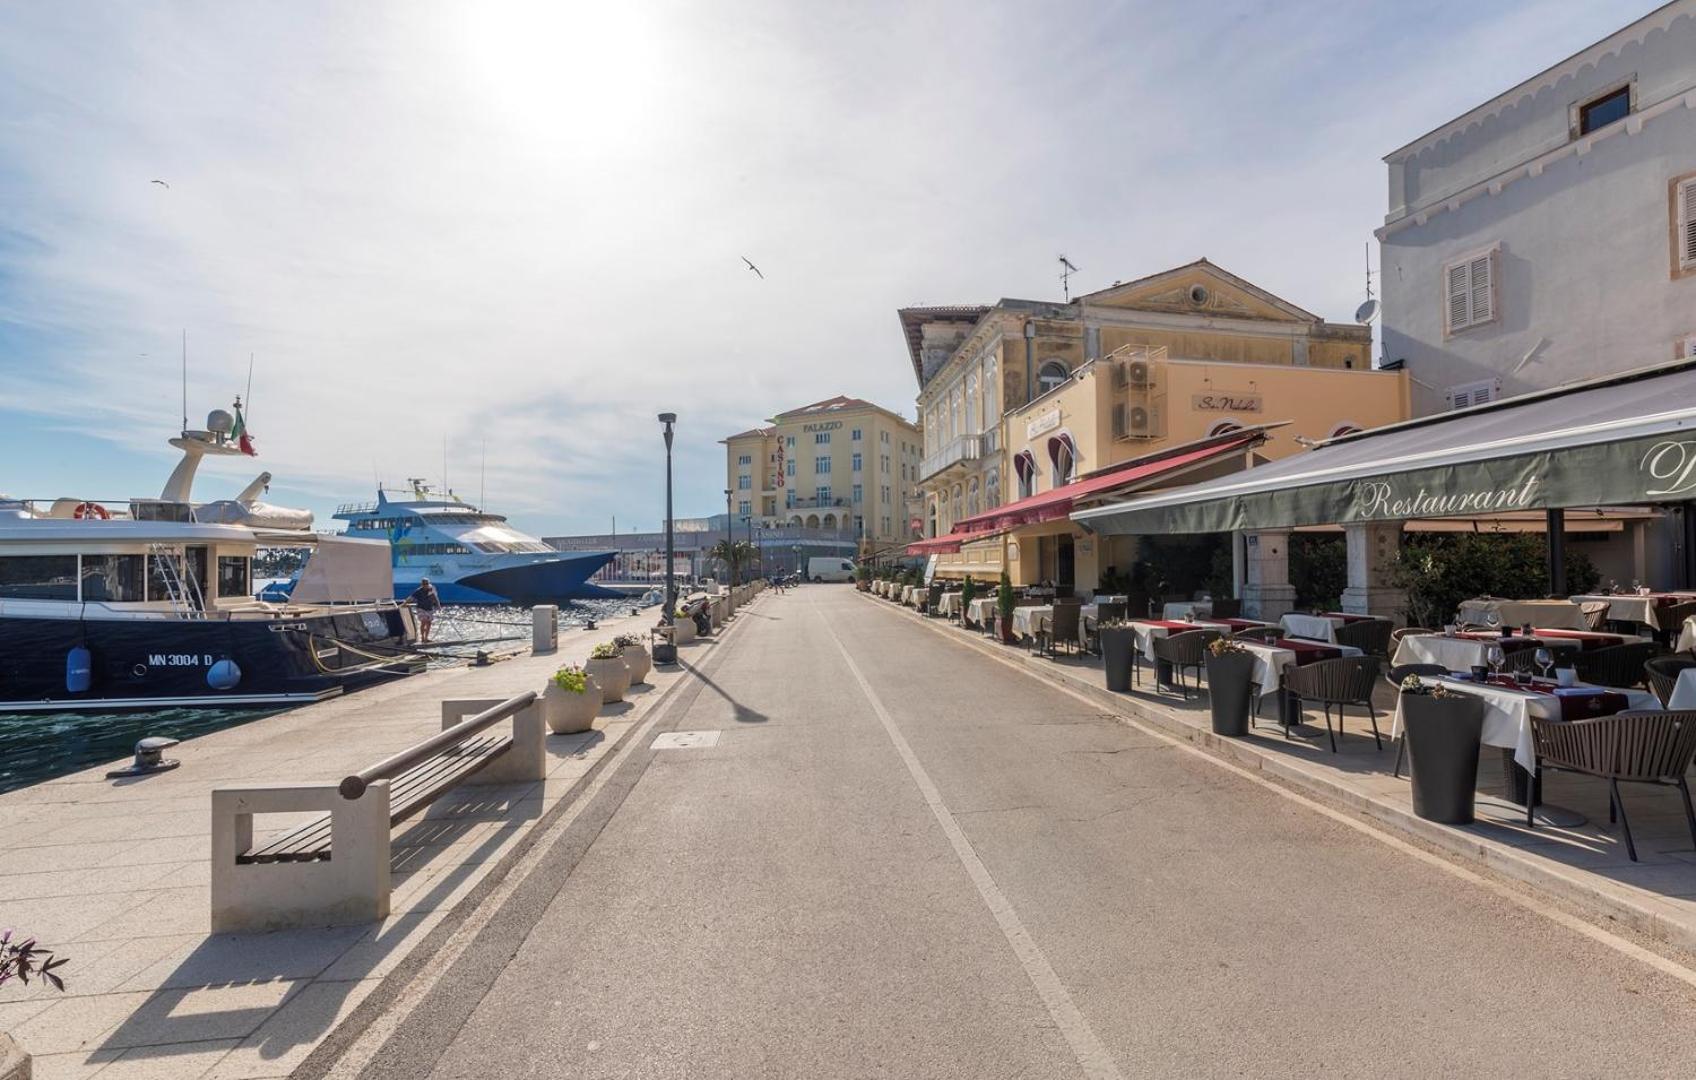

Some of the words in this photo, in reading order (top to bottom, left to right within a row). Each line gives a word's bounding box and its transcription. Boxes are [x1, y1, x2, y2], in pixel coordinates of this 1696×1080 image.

[803, 421, 843, 433] PALAZZO
[777, 435, 785, 487] CASINO
[1360, 475, 1540, 518] Restaurant
[148, 654, 167, 666] MN
[167, 654, 199, 666] 3004
[203, 654, 213, 666] D
